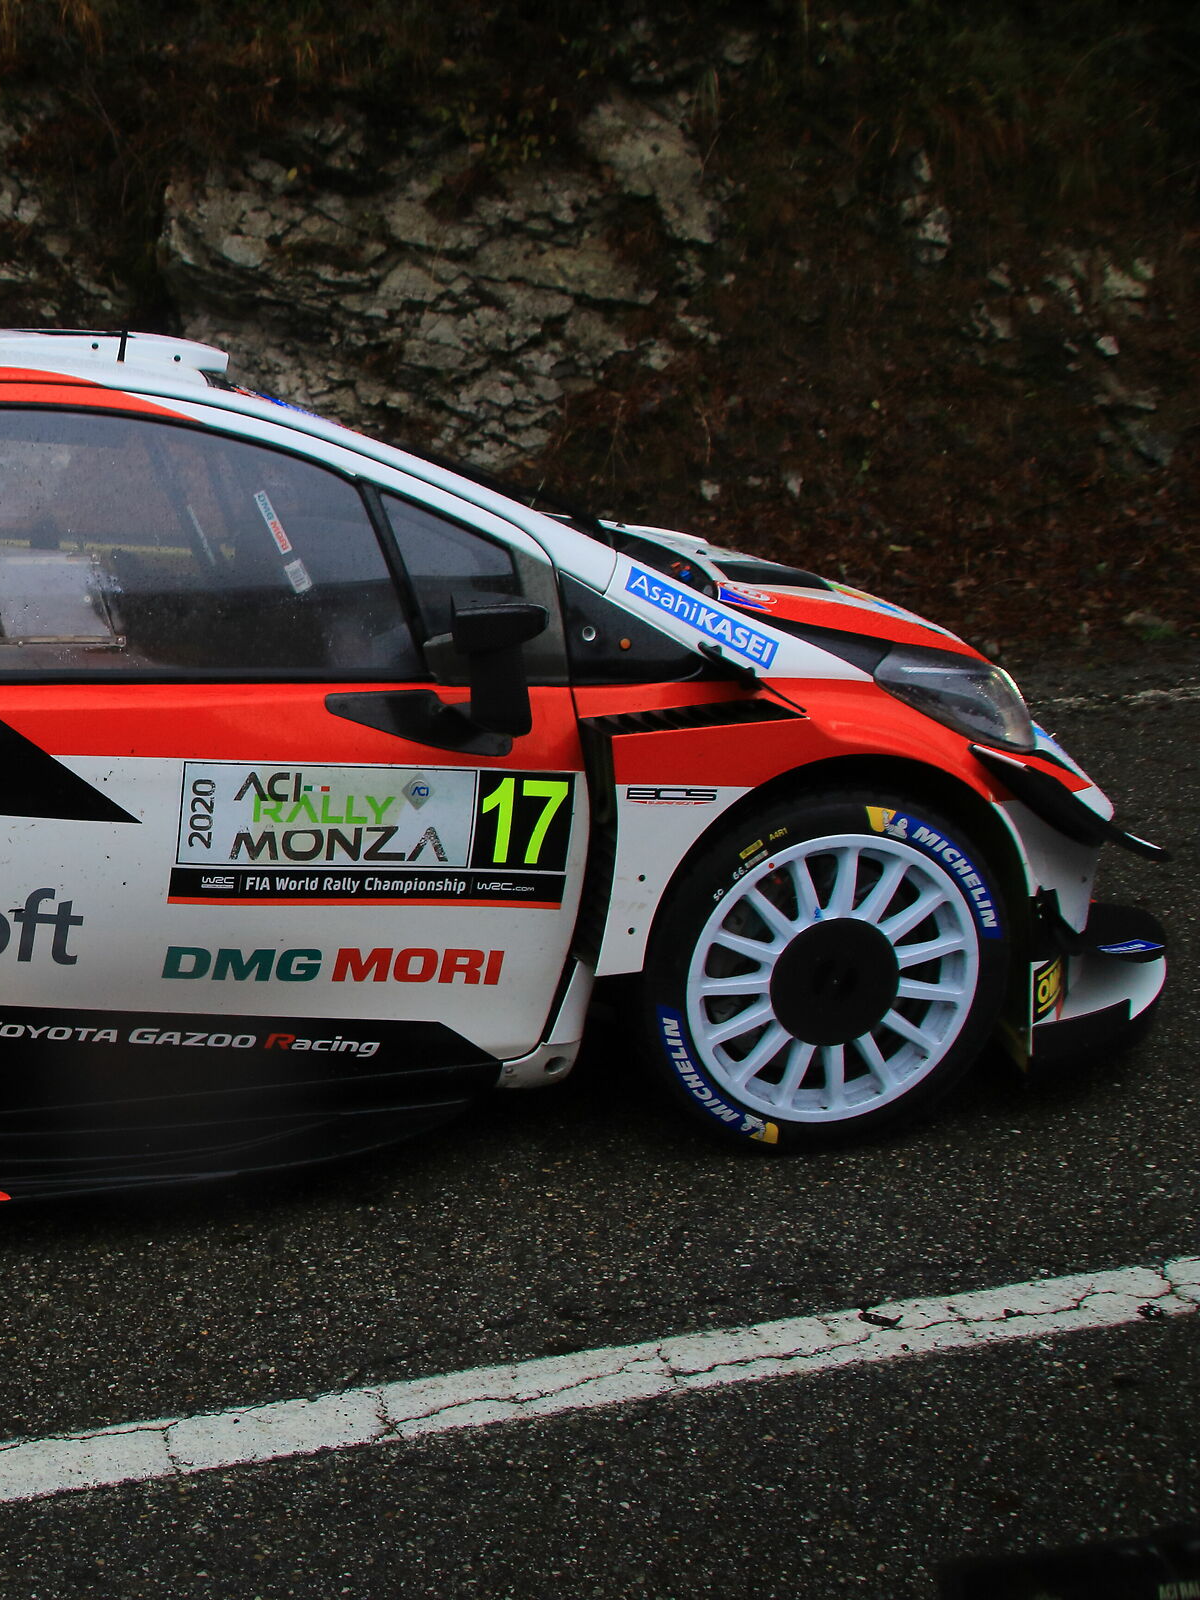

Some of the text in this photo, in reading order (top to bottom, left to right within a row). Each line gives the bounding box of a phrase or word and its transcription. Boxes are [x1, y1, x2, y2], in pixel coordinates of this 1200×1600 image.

[630, 574, 774, 663] AsahiKASEI
[233, 772, 303, 803] ACI
[188, 778, 216, 849] 2020
[252, 793, 397, 824] RALLY
[482, 777, 569, 864] 17
[228, 825, 449, 863] MONZA
[201, 876, 235, 885] WRC
[245, 877, 467, 894] FIA World Rally Championship
[911, 826, 998, 928] MICHELIN
[161, 946, 505, 986] DMG MORI
[128, 1027, 257, 1050] GAZOO
[264, 1033, 381, 1058] Racing
[662, 1017, 740, 1122] MICHELIN
